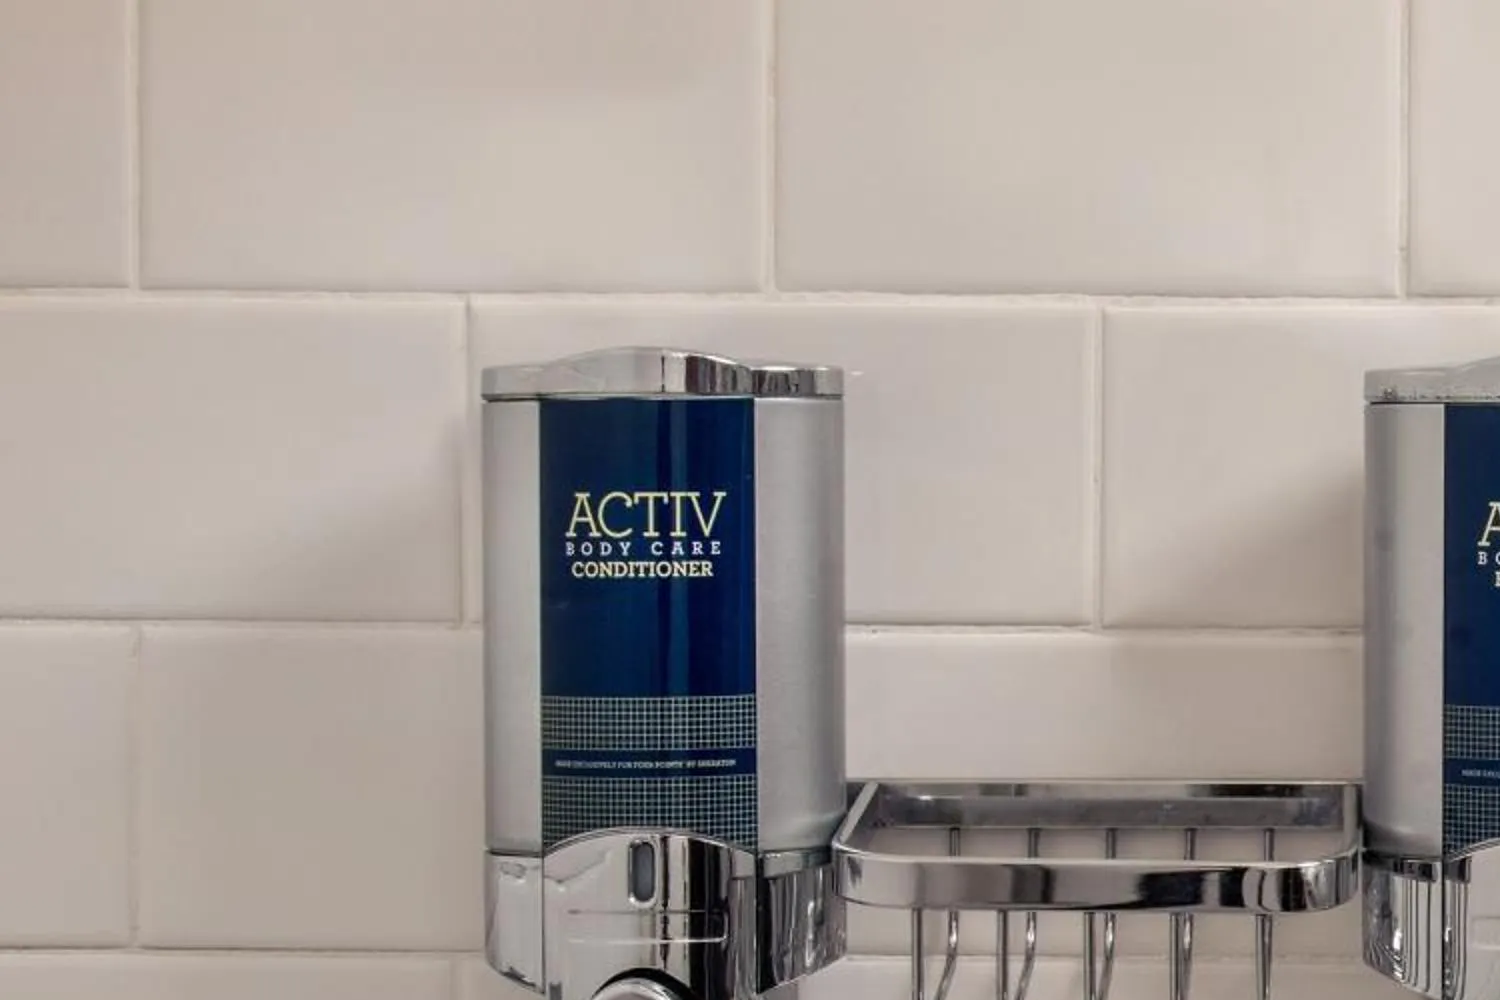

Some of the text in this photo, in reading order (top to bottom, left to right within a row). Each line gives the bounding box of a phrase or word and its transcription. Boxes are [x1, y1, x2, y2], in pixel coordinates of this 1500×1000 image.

[565, 491, 727, 538] ACTIV
[565, 541, 721, 556] BODY CARE
[571, 561, 714, 578] CONDITIONER
